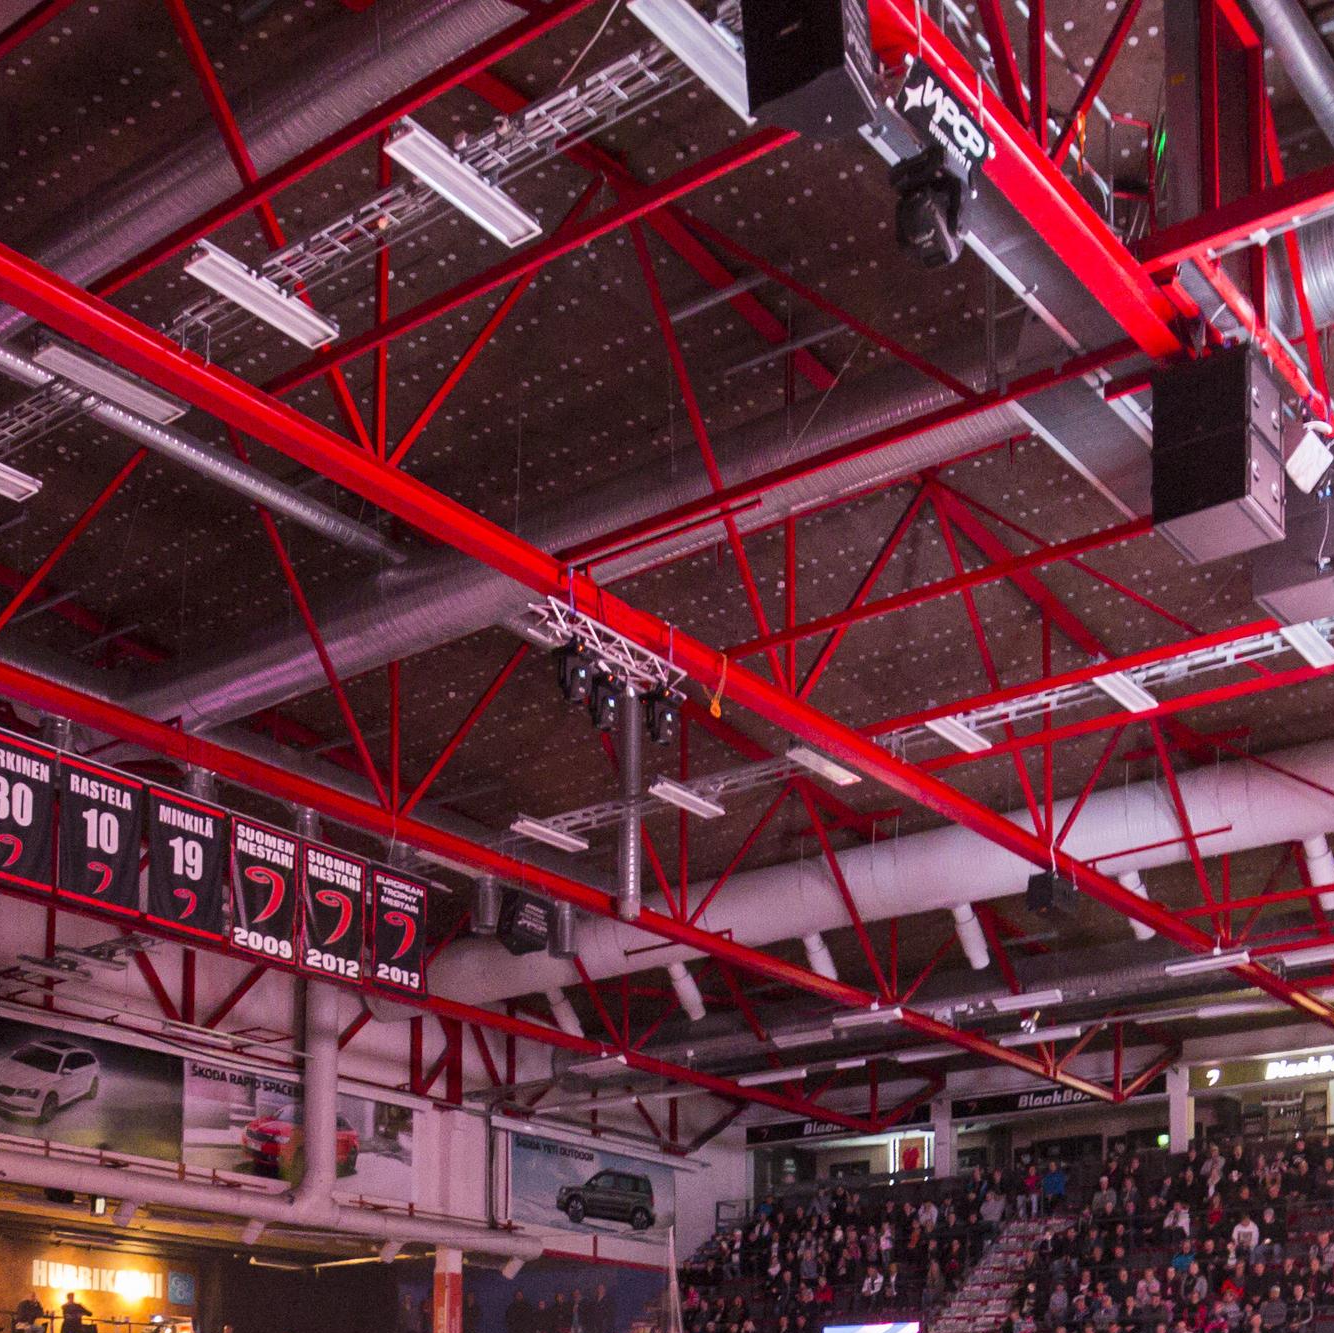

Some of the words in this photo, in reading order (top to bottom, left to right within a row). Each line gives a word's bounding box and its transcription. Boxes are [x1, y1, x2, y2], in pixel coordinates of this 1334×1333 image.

[70, 773, 132, 811] RASTELA
[82, 808, 120, 855] 10
[159, 804, 214, 839] MIKKILÄ
[236, 837, 294, 870] MESTARI
[237, 823, 295, 855] SUOMEN
[169, 836, 204, 881] 19
[308, 849, 362, 876] SUOMEN
[308, 863, 361, 893] MESTARI
[376, 874, 424, 897] EUROPEAN
[383, 886, 418, 903] TROPHY
[233, 926, 293, 960] 2009
[306, 948, 360, 979] 2012
[376, 963, 420, 989] 2013
[191, 1063, 227, 1082] ŠKODA
[229, 1073, 261, 1091] RAPID
